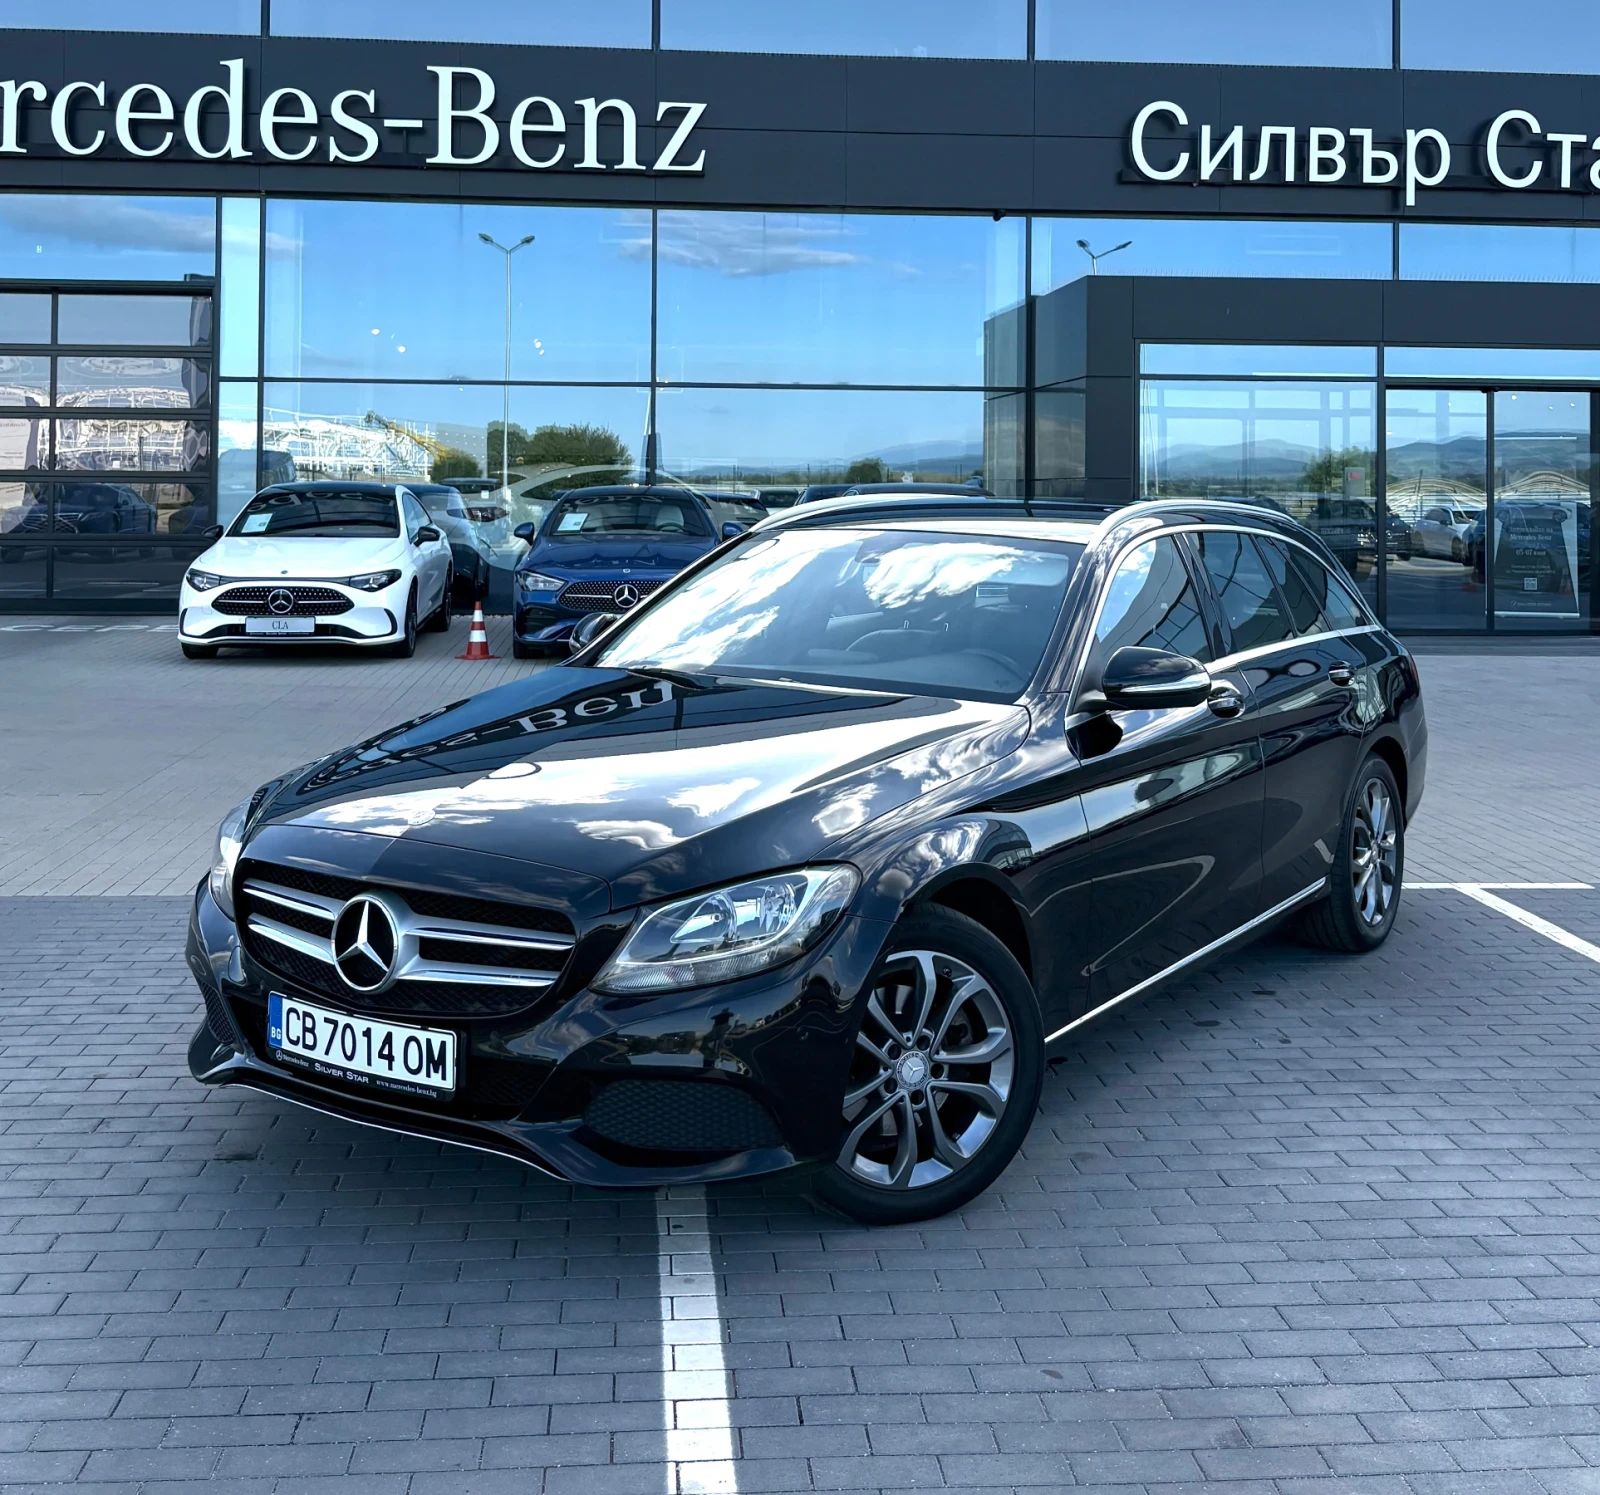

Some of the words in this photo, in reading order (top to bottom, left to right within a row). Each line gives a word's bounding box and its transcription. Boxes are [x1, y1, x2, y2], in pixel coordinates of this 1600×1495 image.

[1131, 100, 1451, 206] Силвър
[272, 620, 289, 630] CLA
[271, 1026, 282, 1040] BG
[346, 1071, 369, 1084] STAR
